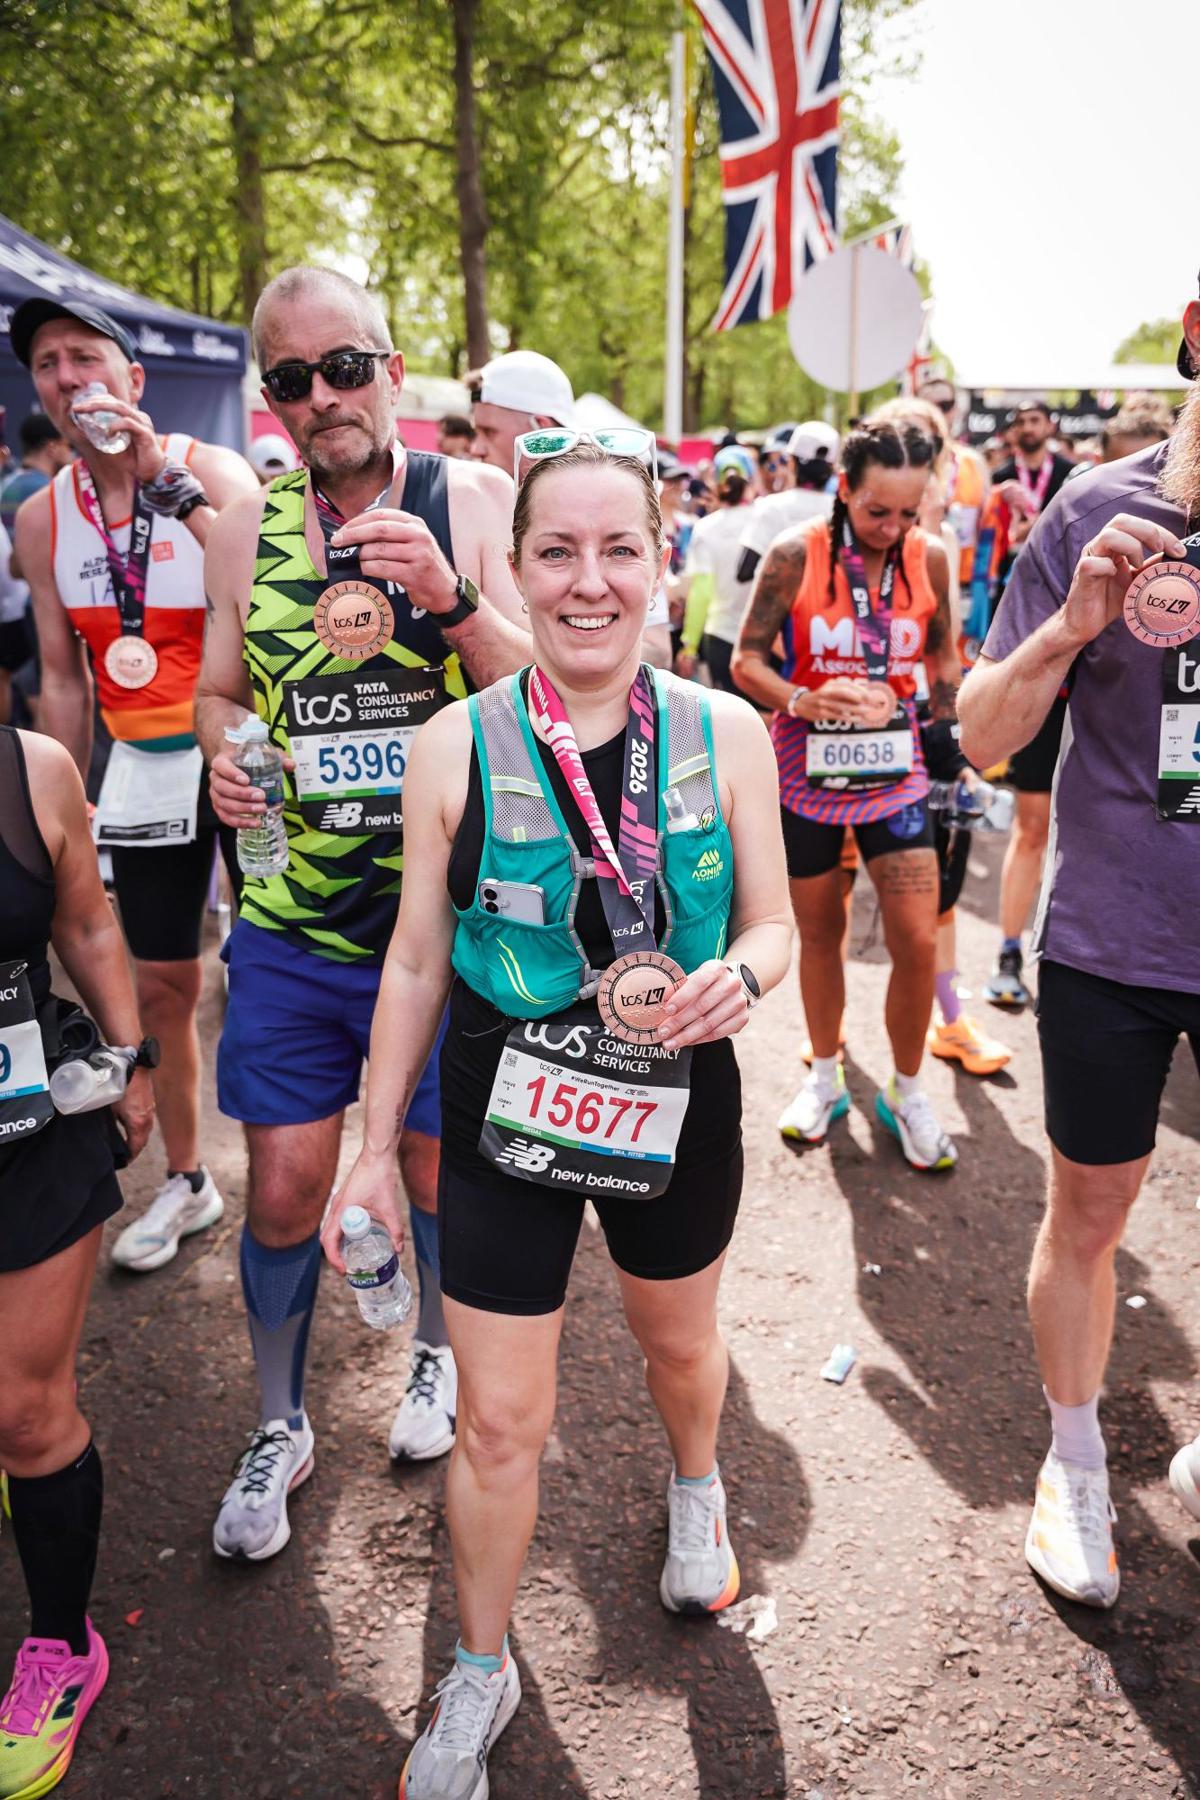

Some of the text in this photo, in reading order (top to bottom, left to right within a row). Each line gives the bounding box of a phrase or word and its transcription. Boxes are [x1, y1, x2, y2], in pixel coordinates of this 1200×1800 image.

[329, 549, 342, 559] tcs
[1146, 593, 1168, 609] tcs
[333, 617, 353, 629] tcs
[292, 682, 389, 727] tcs TATA
[356, 689, 436, 708] CONSULTANCY
[359, 706, 409, 721] SERVICES
[824, 742, 895, 767] 60638
[629, 738, 649, 795] 2026
[365, 815, 391, 827] new
[613, 927, 630, 937] tcs
[620, 994, 644, 1008] tcs
[597, 1038, 681, 1060] CONSULTANCY
[592, 1053, 652, 1074] SERVICES
[526, 1074, 659, 1143] 15677
[550, 1167, 651, 1194] new balance
